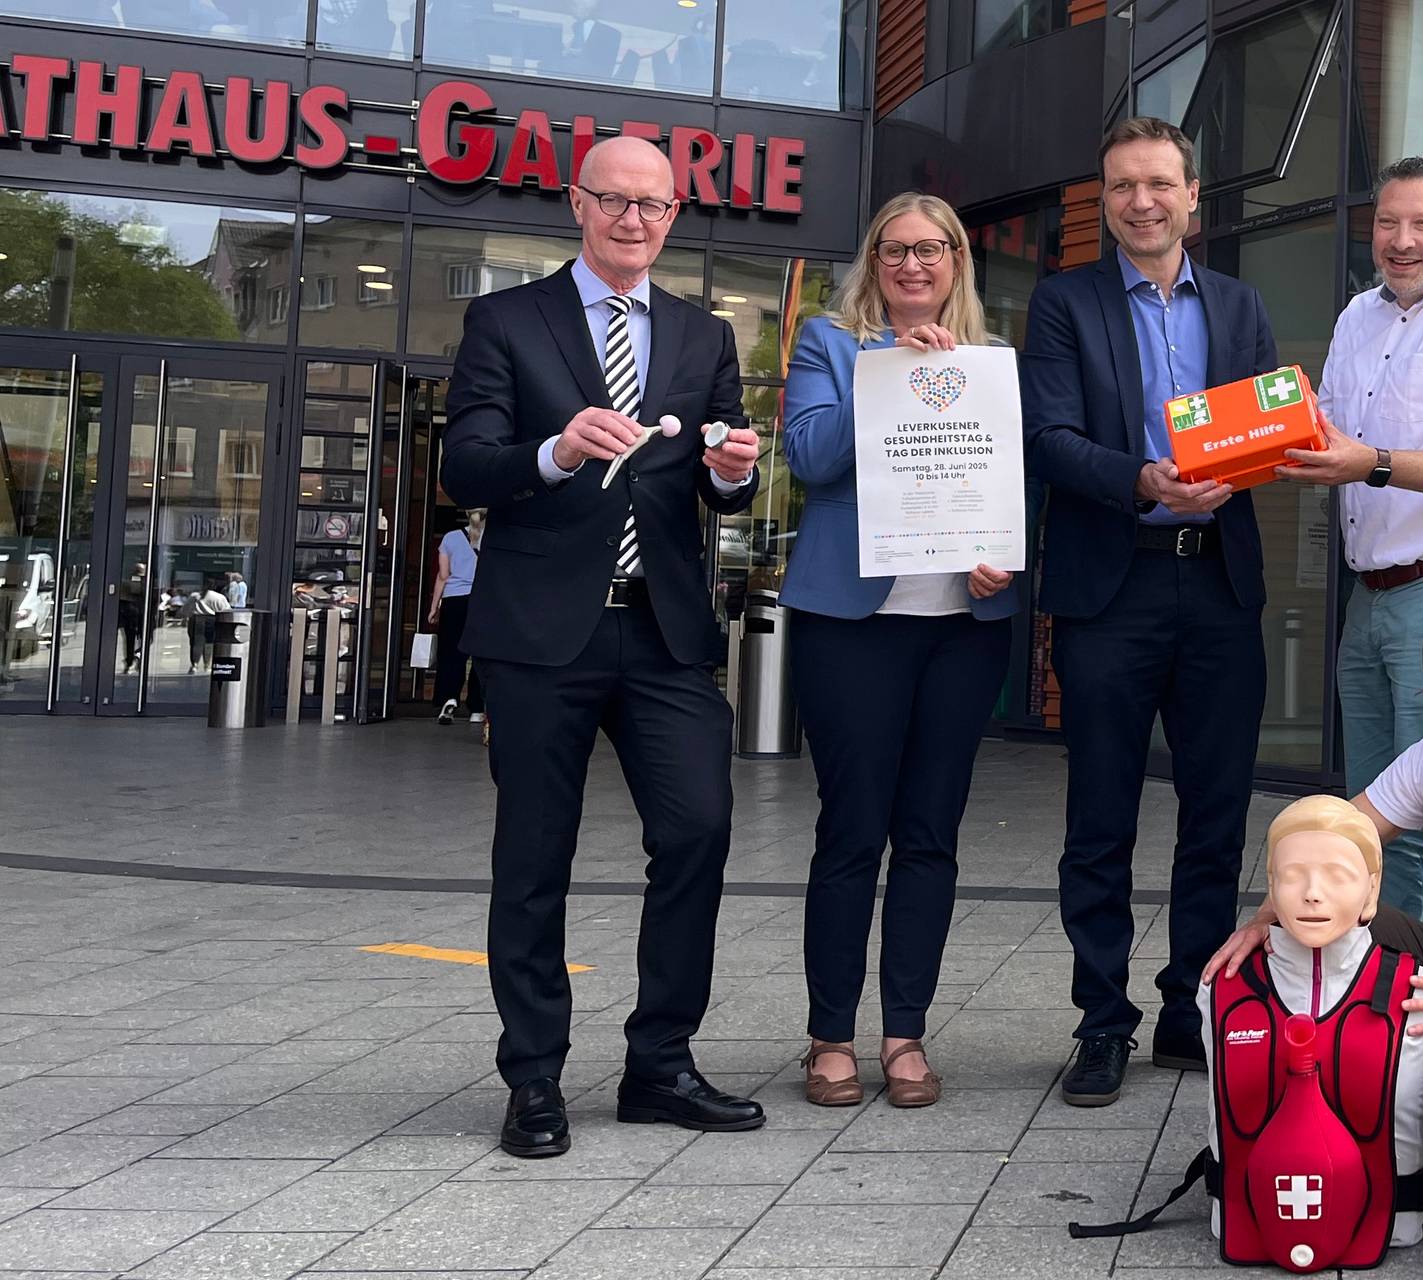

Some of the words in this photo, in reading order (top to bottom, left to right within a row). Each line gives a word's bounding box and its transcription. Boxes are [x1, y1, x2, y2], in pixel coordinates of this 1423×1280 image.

[897, 421, 980, 433] LEVERKUSENER
[884, 434, 983, 445] GESUNDHEITSTAG
[985, 433, 993, 442] &
[1202, 434, 1245, 452] Erste
[1248, 423, 1286, 440] Hilfe
[885, 448, 909, 458] TAG
[910, 447, 932, 457] DER
[934, 446, 993, 456] INKLUSION
[891, 465, 932, 473] Samstag,
[948, 462, 967, 470] Juni
[968, 462, 988, 470] 2025
[926, 472, 939, 480] bis
